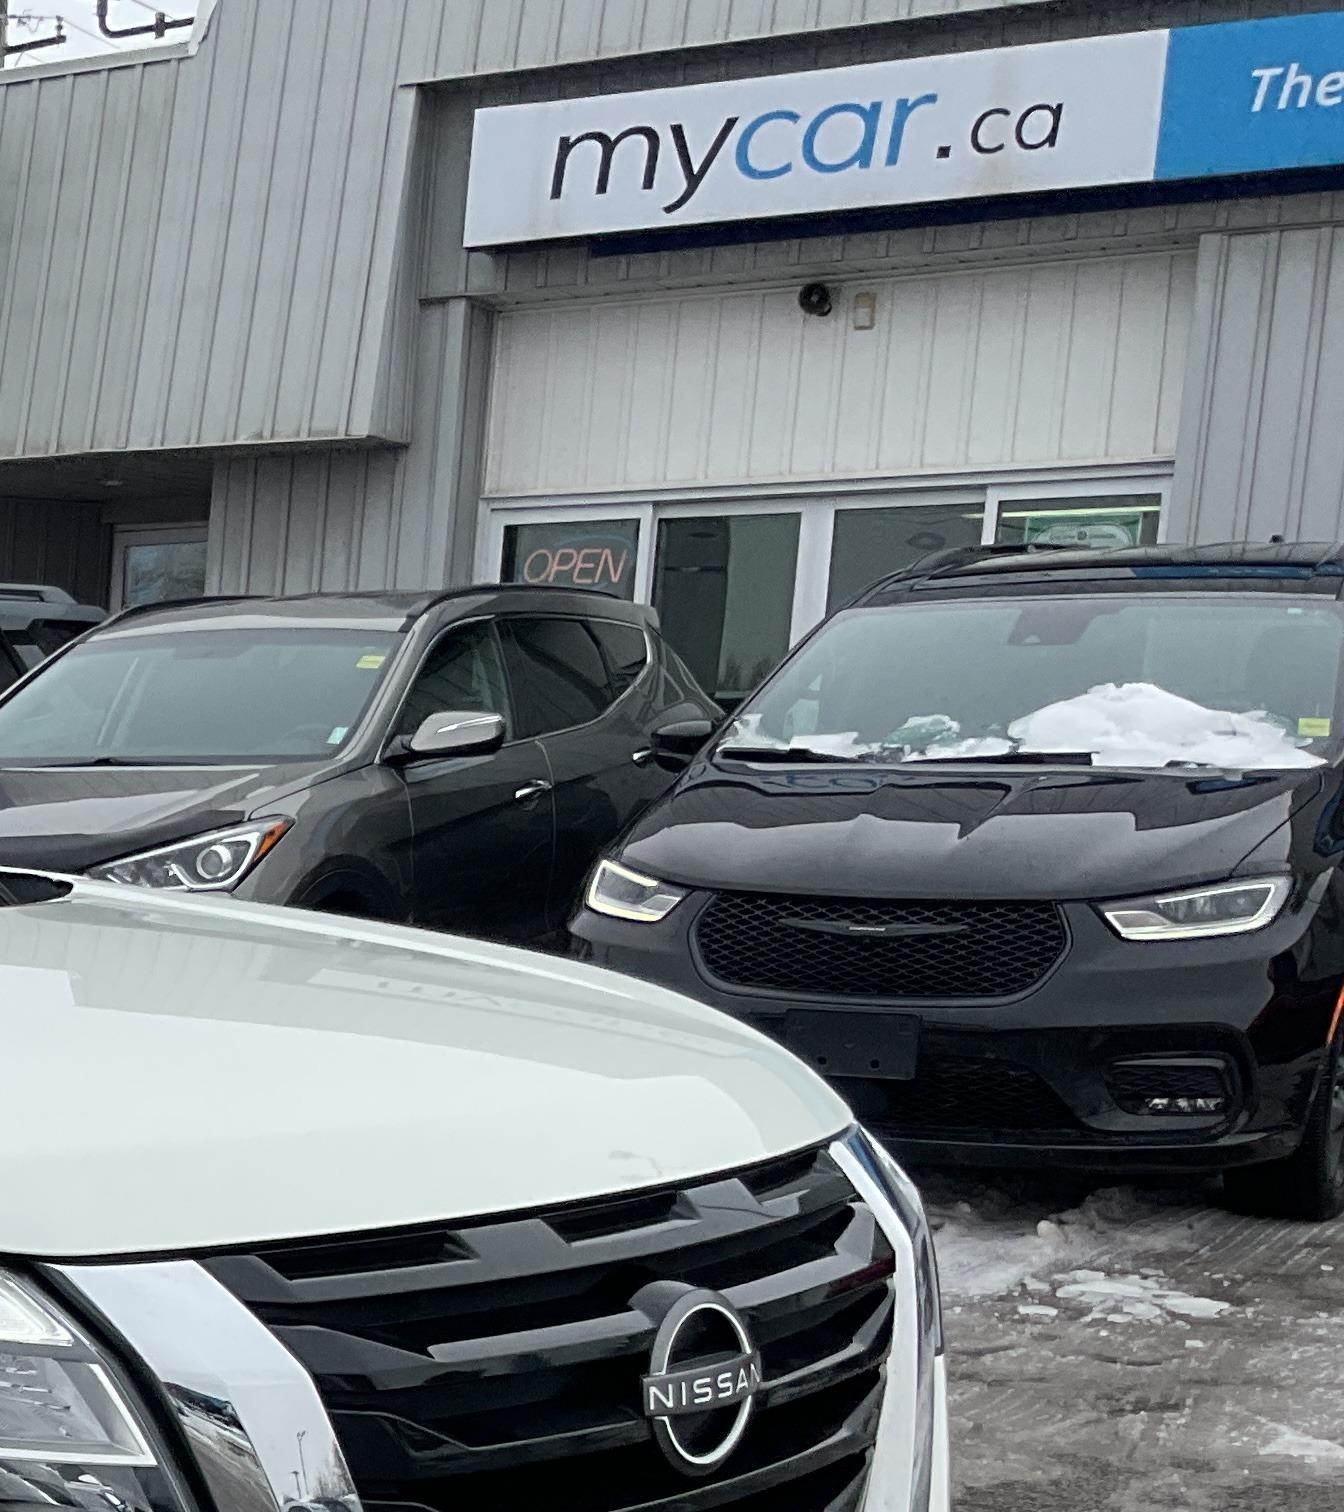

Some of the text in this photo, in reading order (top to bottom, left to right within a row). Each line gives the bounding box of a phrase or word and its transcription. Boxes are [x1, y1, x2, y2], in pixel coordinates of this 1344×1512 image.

[1252, 63, 1344, 112] The
[550, 92, 1064, 213] mycar.ca
[524, 548, 627, 584] OPEN
[649, 1363, 760, 1410] NISSAN
